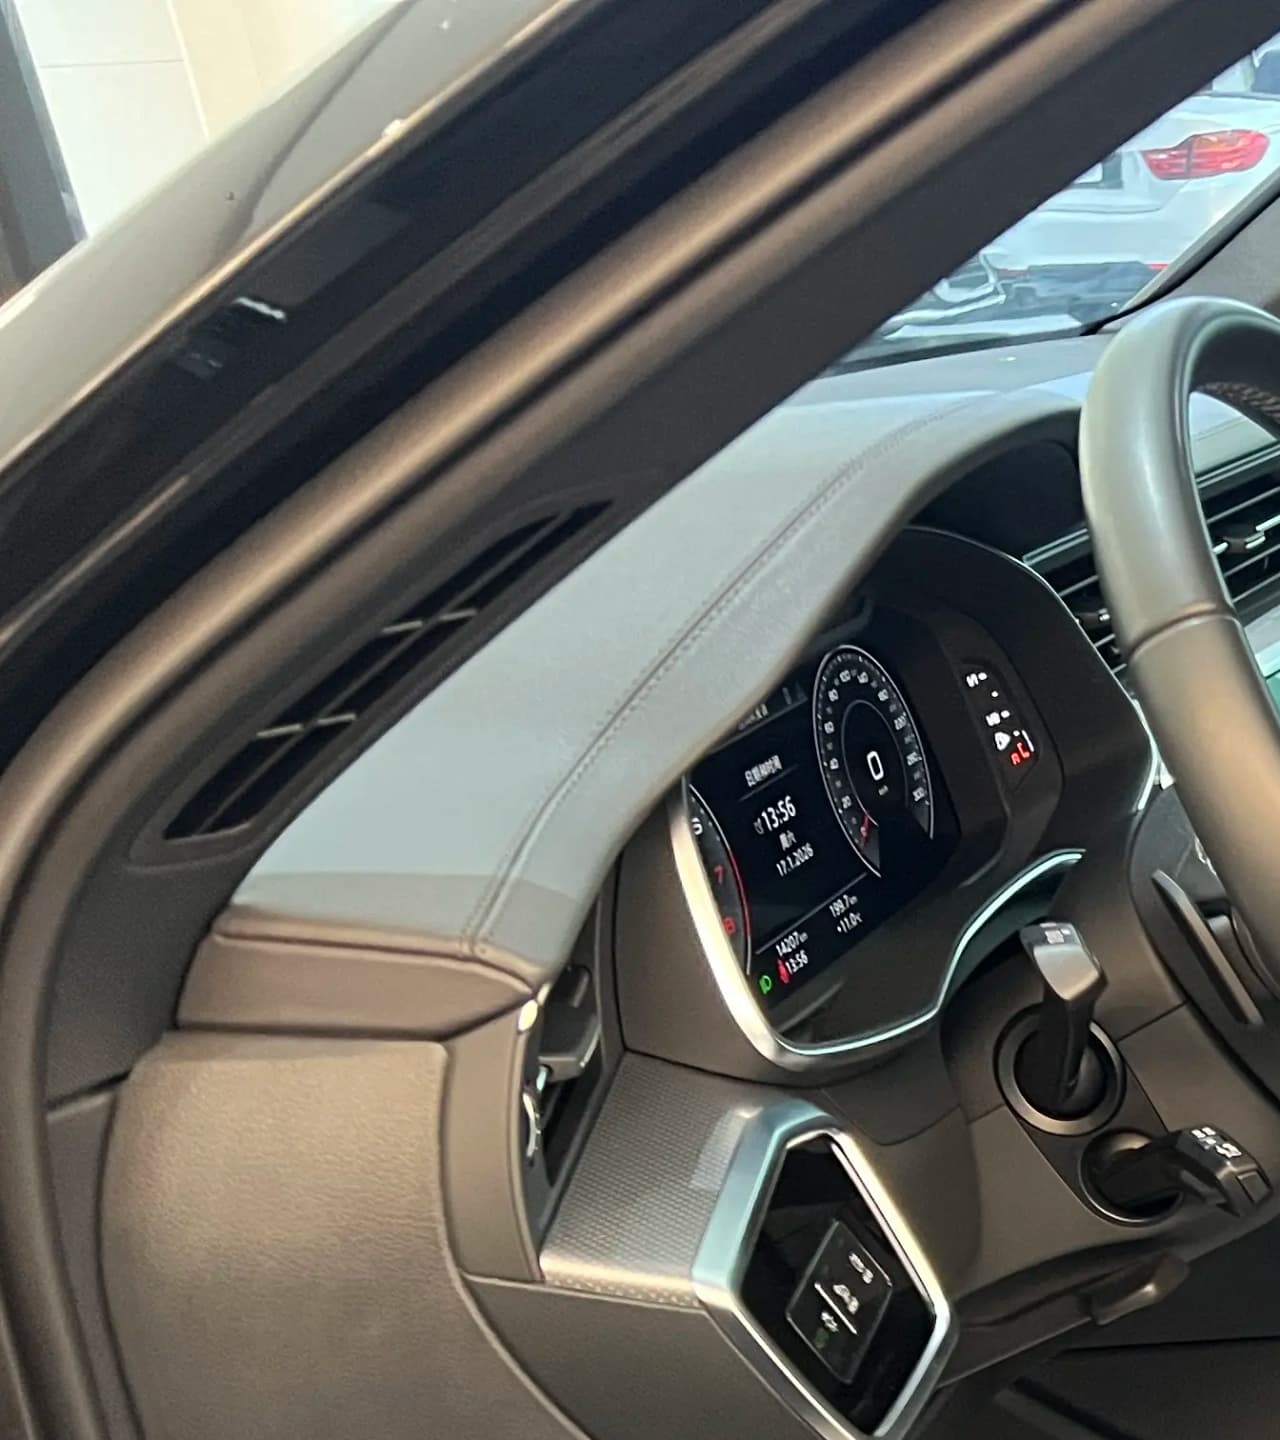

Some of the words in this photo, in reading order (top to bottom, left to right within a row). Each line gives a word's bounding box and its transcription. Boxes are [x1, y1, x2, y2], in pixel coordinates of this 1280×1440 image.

[866, 750, 884, 781] 0
[761, 794, 797, 832] 13:56
[785, 948, 809, 975] 13:56
